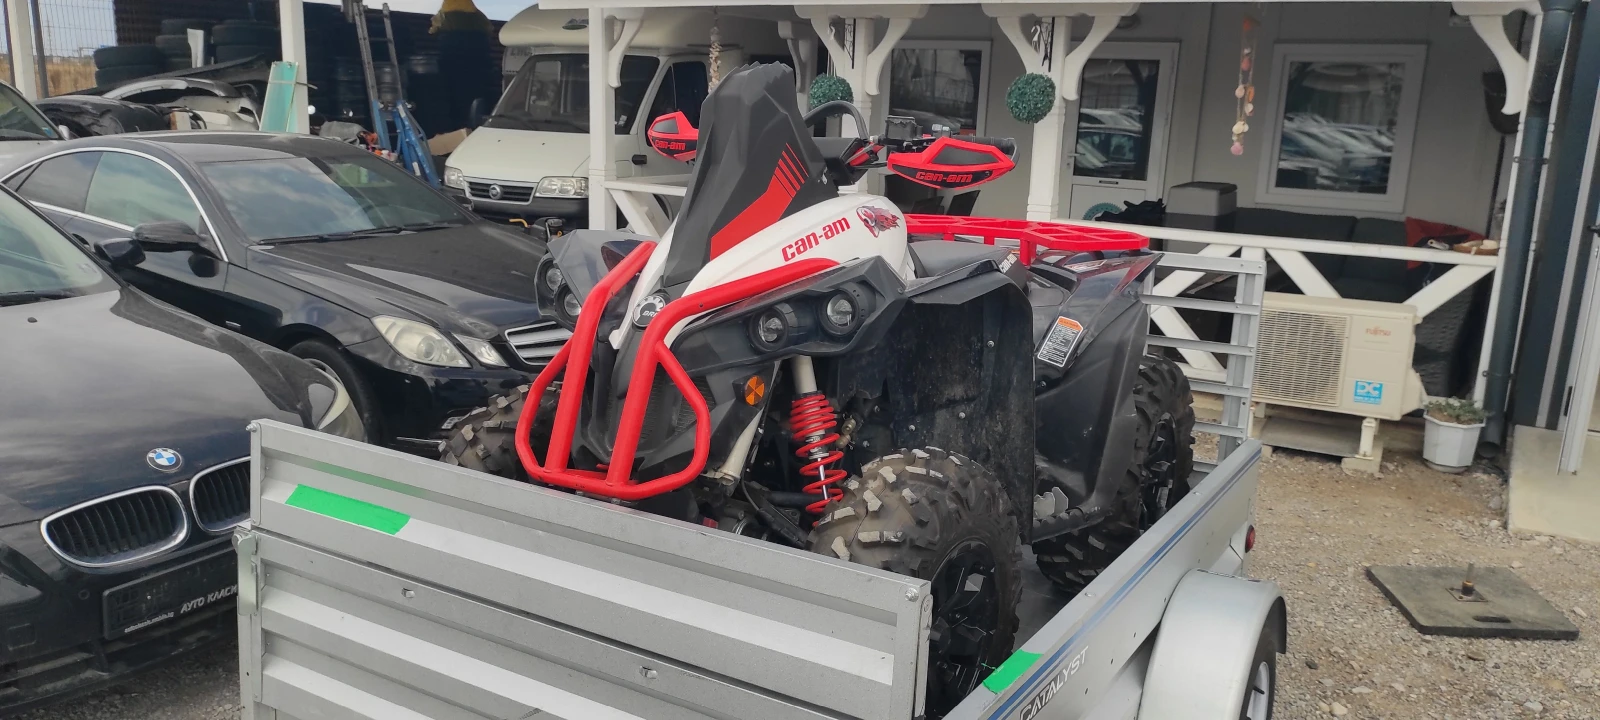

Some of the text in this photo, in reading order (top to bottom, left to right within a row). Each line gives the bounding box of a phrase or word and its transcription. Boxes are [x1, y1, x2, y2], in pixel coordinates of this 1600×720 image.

[655, 139, 686, 150] can-am
[915, 171, 973, 183] can-am
[781, 217, 851, 262] can-am
[1356, 381, 1381, 396] DC
[180, 584, 238, 614] АУТО КЛАСИ
[1020, 646, 1089, 720] CATALYST
